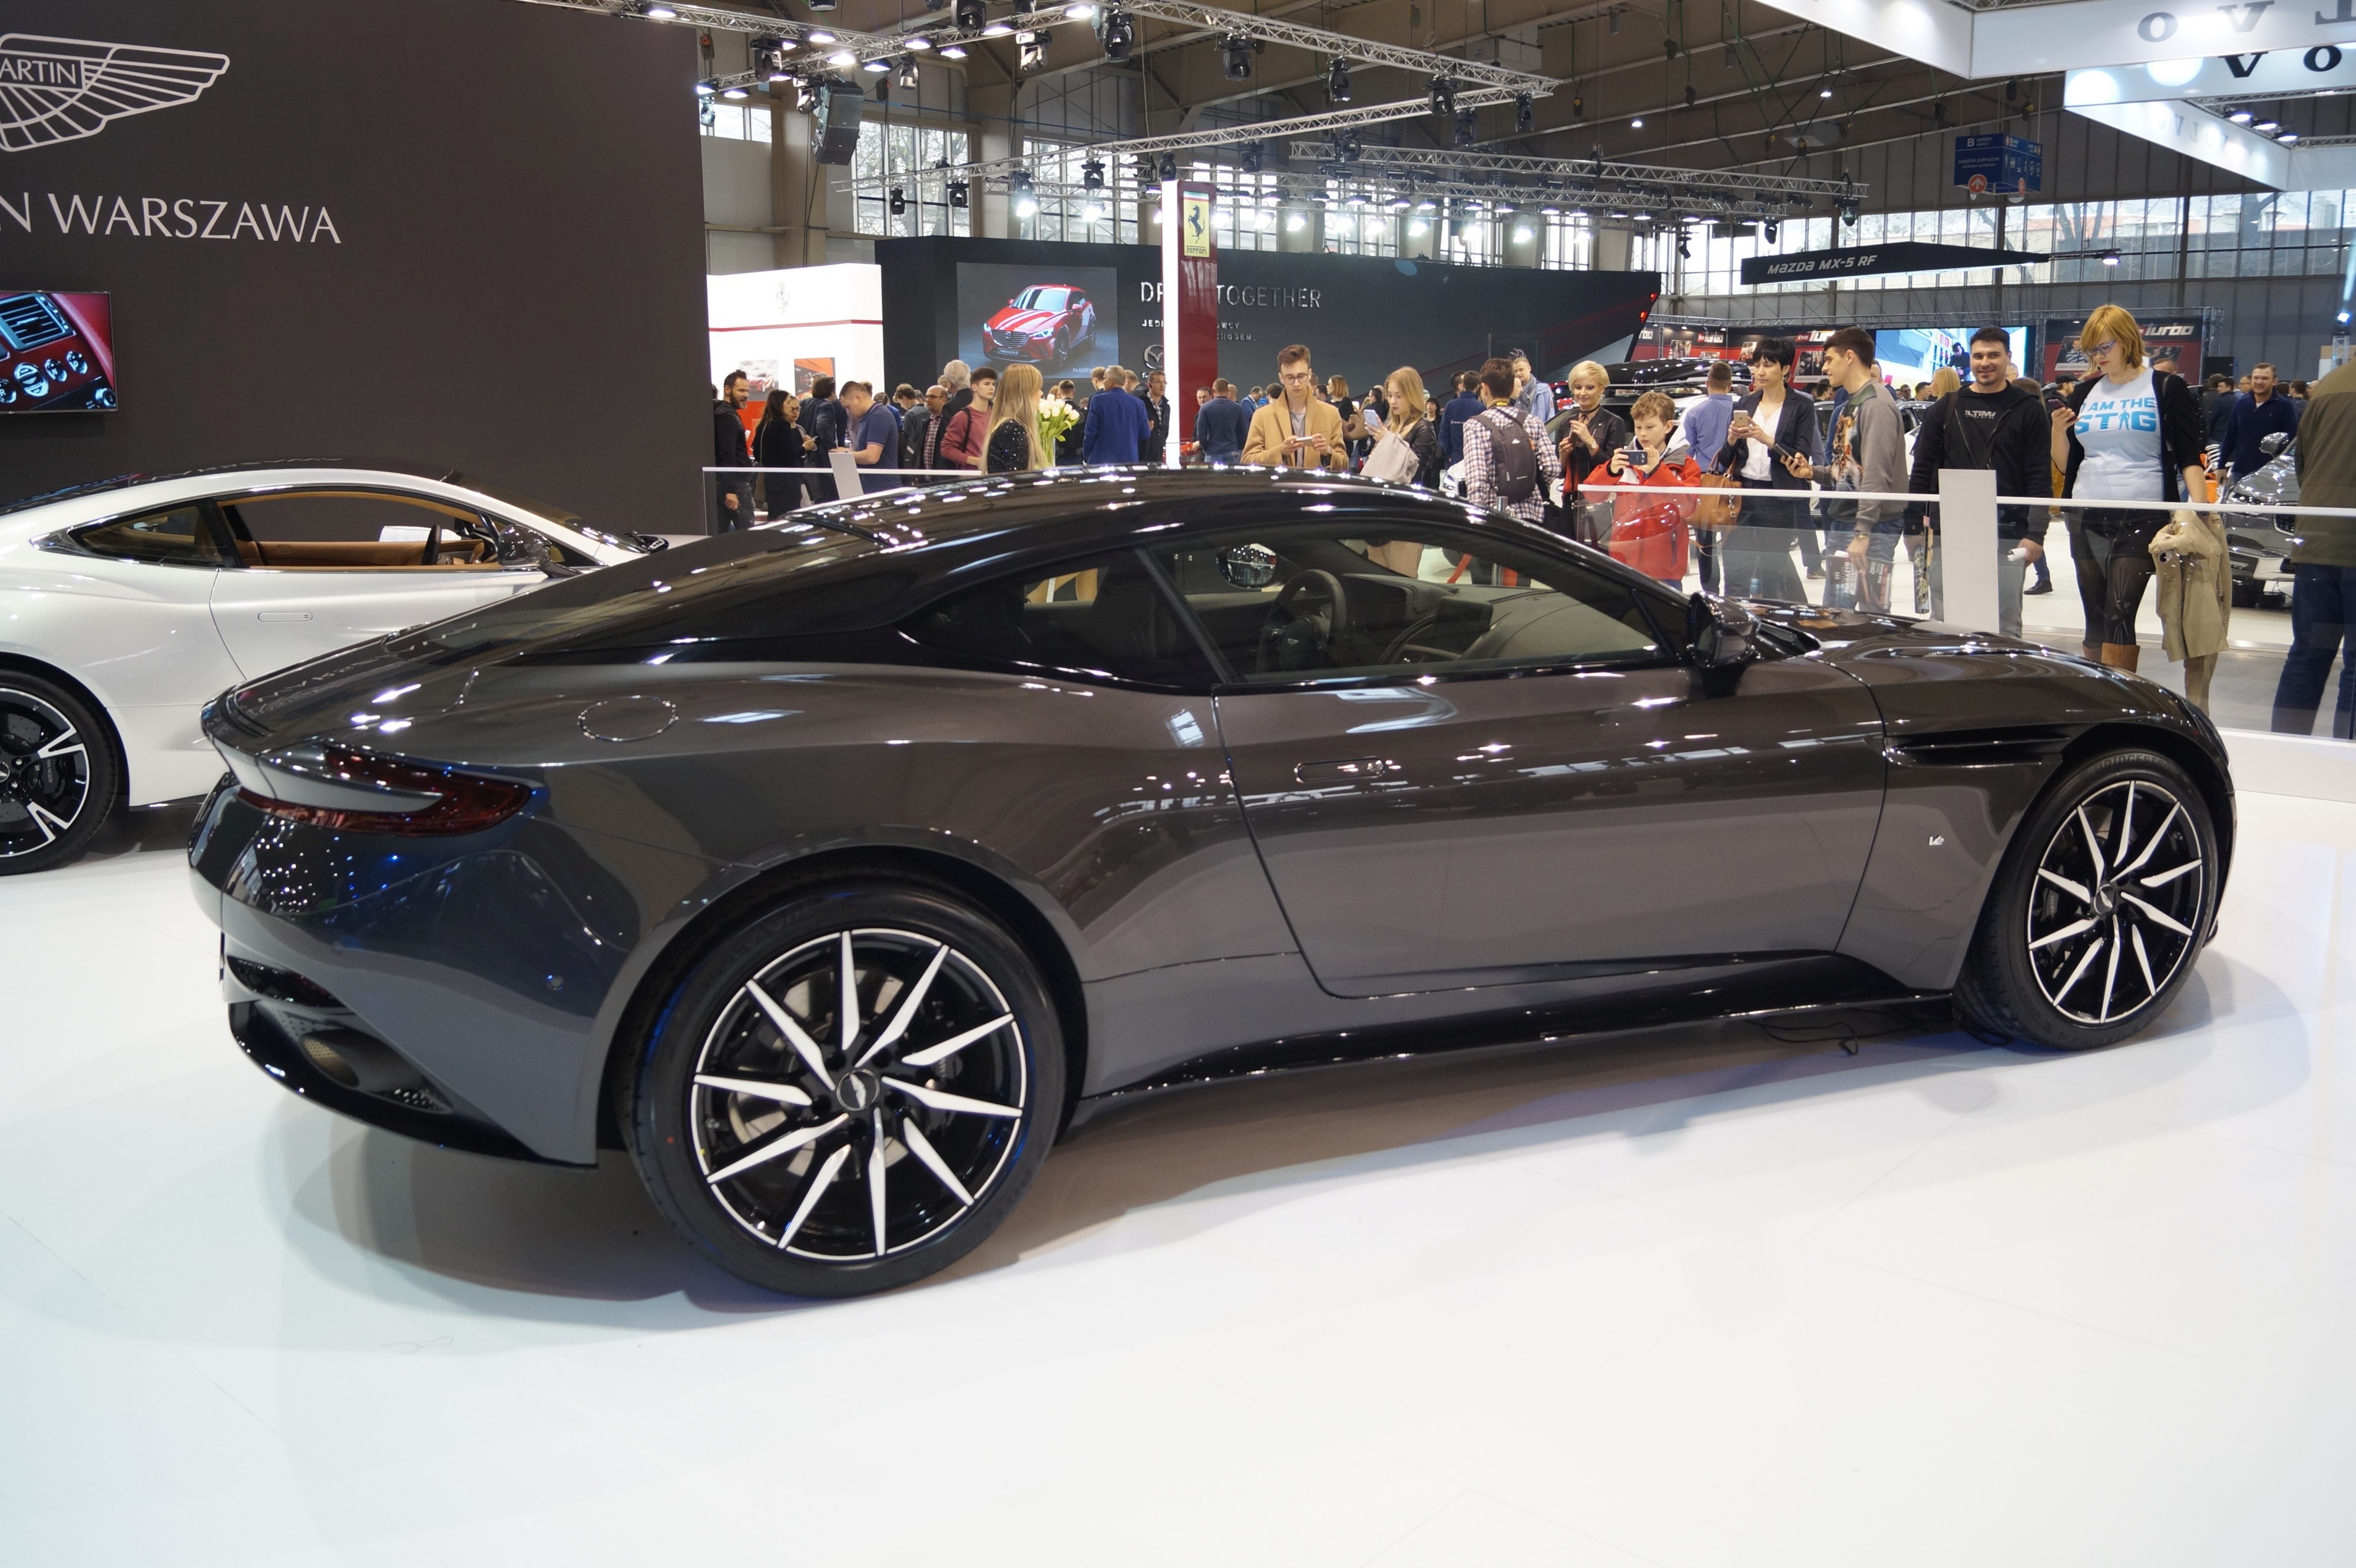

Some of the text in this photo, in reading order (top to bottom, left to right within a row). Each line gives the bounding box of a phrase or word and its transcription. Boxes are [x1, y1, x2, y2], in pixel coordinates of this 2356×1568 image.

[0, 57, 76, 85] ARTIN
[1967, 138, 1974, 147] B
[47, 193, 342, 244] WARSZAWA
[1186, 245, 1207, 254] Ferrari
[1819, 257, 1855, 270] MX-5
[1857, 255, 1878, 266] RF
[1216, 285, 1321, 307] TOGETHER
[2142, 322, 2195, 336] turbo
[2087, 401, 2115, 412] AM
[2120, 397, 2157, 409] THE
